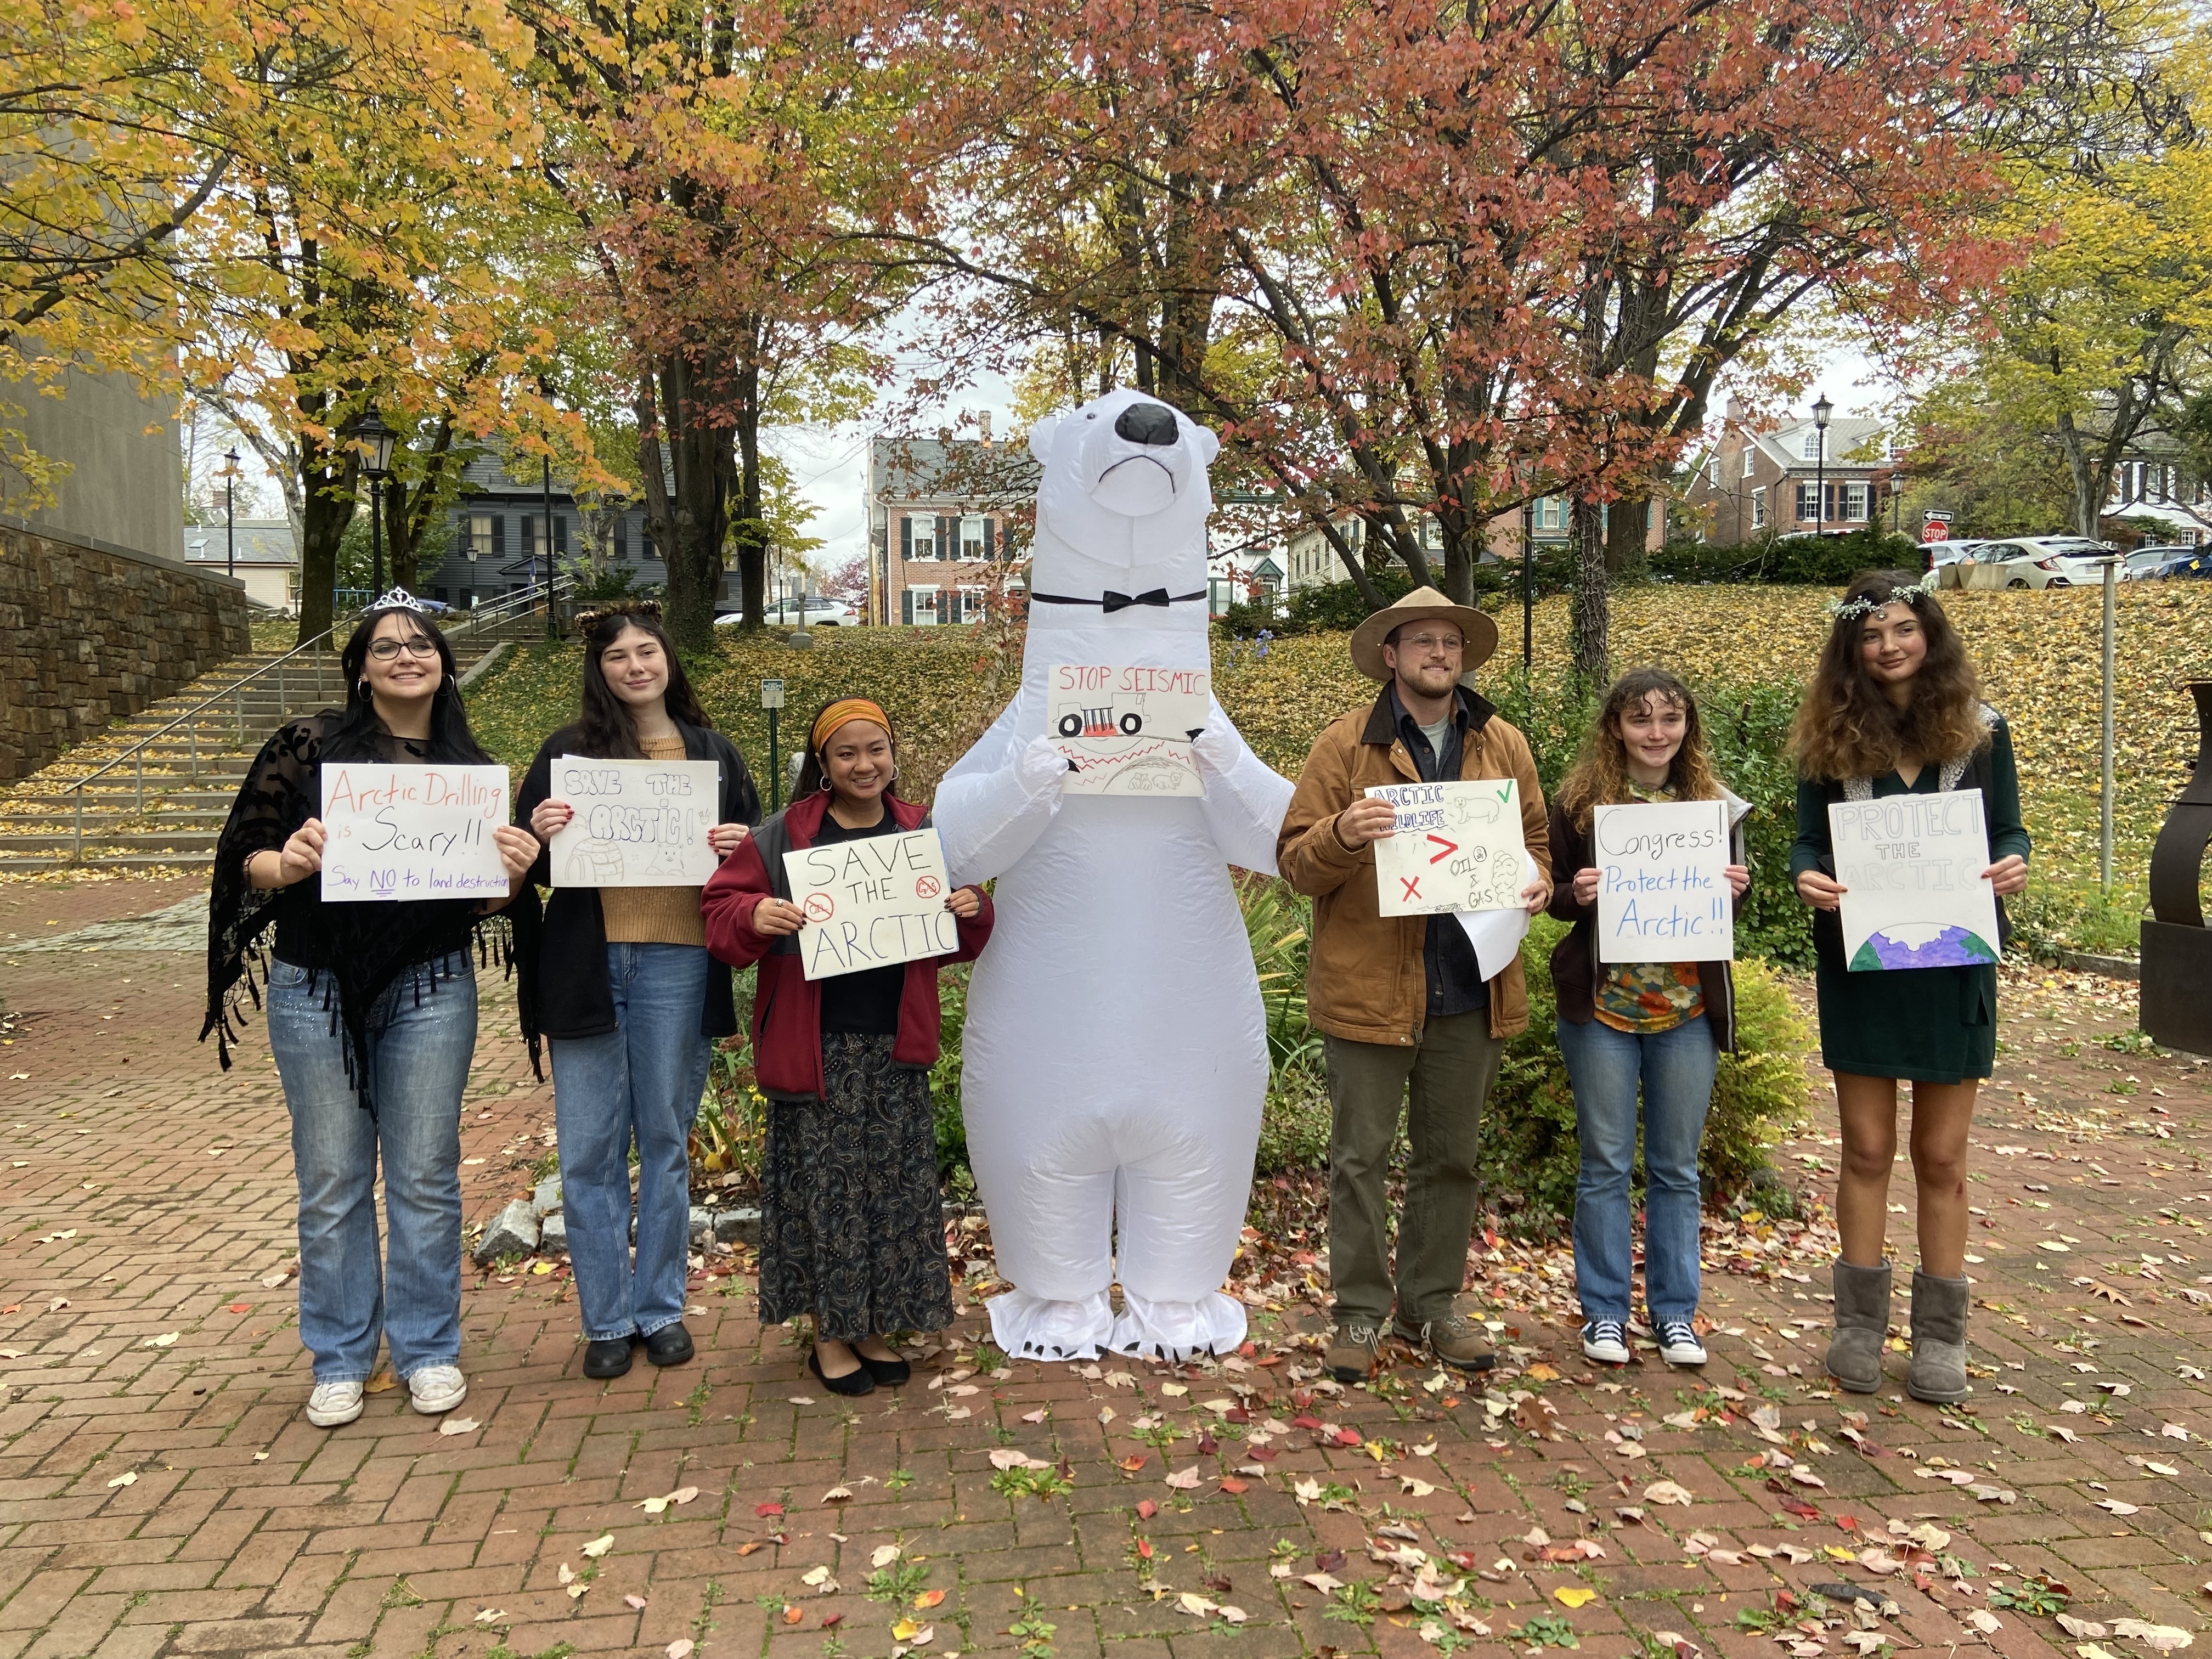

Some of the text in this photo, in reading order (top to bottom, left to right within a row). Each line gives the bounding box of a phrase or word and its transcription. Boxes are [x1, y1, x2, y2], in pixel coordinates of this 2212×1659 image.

[1924, 528, 1946, 539] STOP
[1059, 667, 1206, 696] STOP SEISMIC
[325, 769, 501, 819] Arctic Drilling
[564, 770, 691, 795] SAVE THE
[338, 806, 481, 856] is Scary!!
[1835, 794, 1983, 841] PROTECT
[1599, 804, 1722, 860] Congress!
[807, 834, 931, 887] SAVE
[1875, 842, 1921, 860] THE
[327, 865, 509, 891] Say NO to land destruction
[1450, 857, 1477, 876] OIL
[1605, 865, 1713, 894] Protect the
[1842, 857, 1978, 891] ARCTIC
[845, 877, 897, 904] THE
[918, 882, 937, 895] GAS
[1470, 874, 1481, 888] &
[809, 904, 828, 915] OIL
[1468, 889, 1493, 908] GAS
[1616, 897, 1723, 937] Arctic!!
[812, 911, 955, 974] ARCTIC
